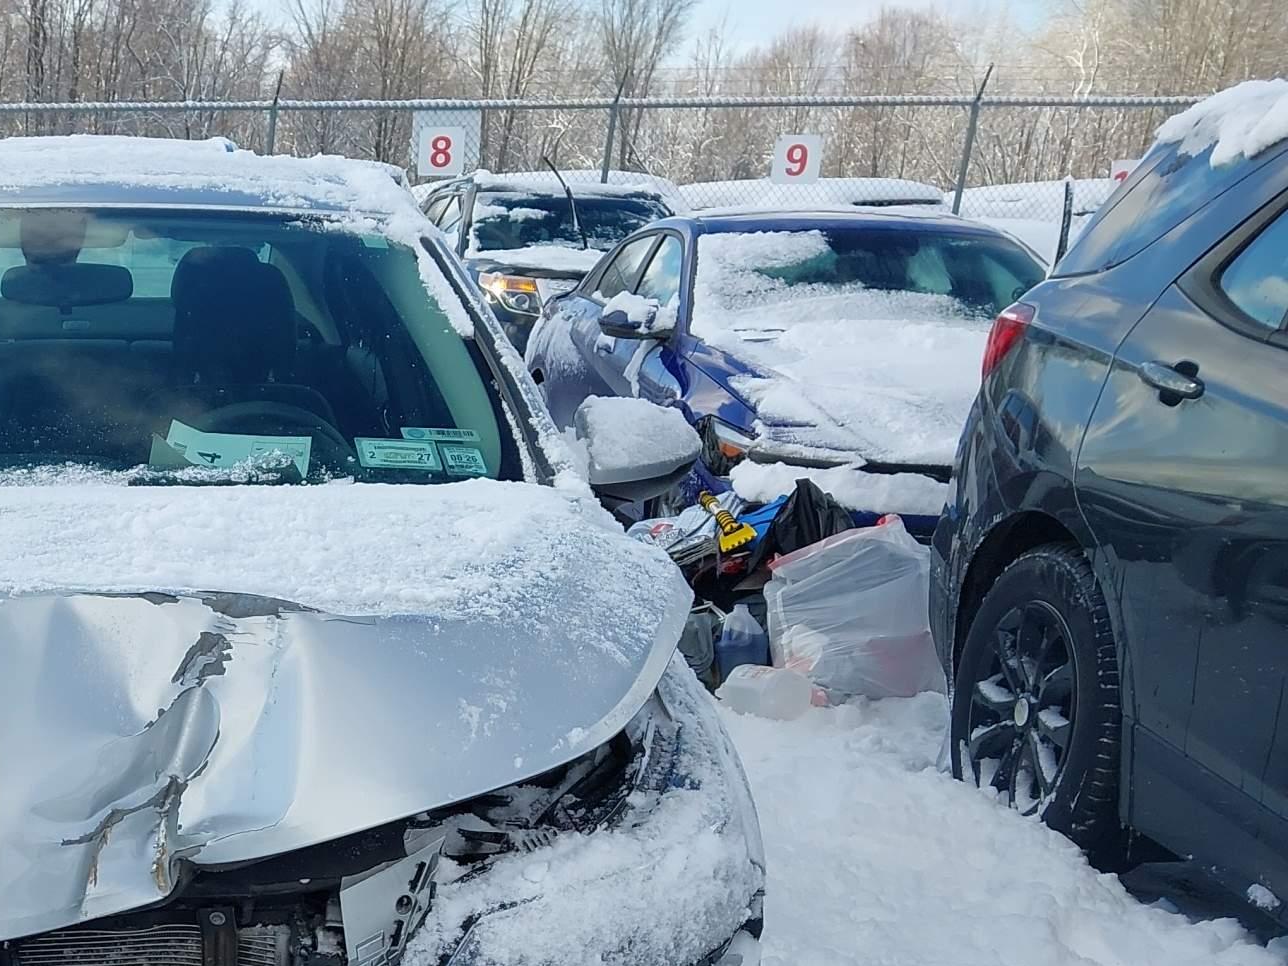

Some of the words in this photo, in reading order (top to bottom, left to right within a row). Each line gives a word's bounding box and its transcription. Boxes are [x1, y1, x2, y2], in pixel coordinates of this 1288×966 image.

[431, 136, 452, 167] 8
[785, 143, 809, 176] 9
[416, 453, 432, 462] 27
